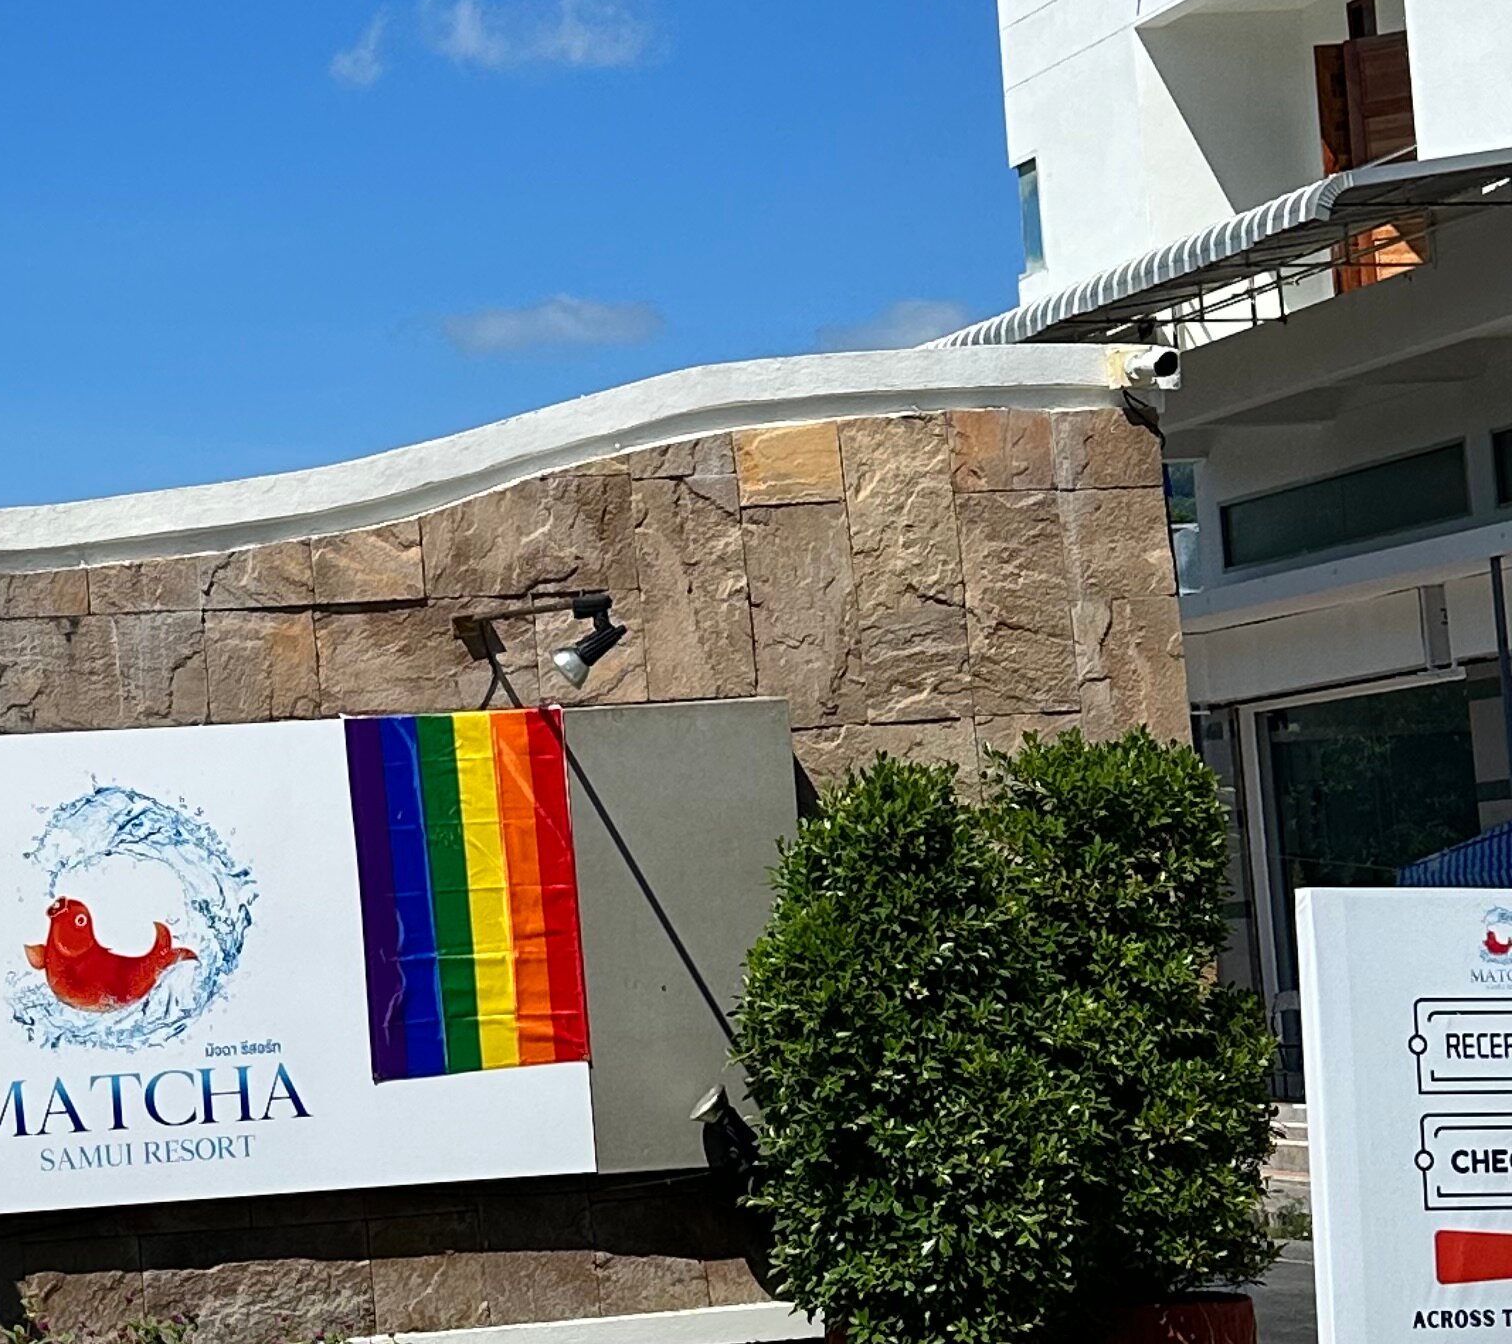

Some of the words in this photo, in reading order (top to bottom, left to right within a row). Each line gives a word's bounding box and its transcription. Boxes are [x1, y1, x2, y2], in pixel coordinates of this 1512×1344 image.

[40, 1142, 133, 1172] SAMUI
[144, 1135, 256, 1164] RESORT
[1451, 1149, 1512, 1174] CHE
[1412, 1308, 1496, 1329] ACROSS
